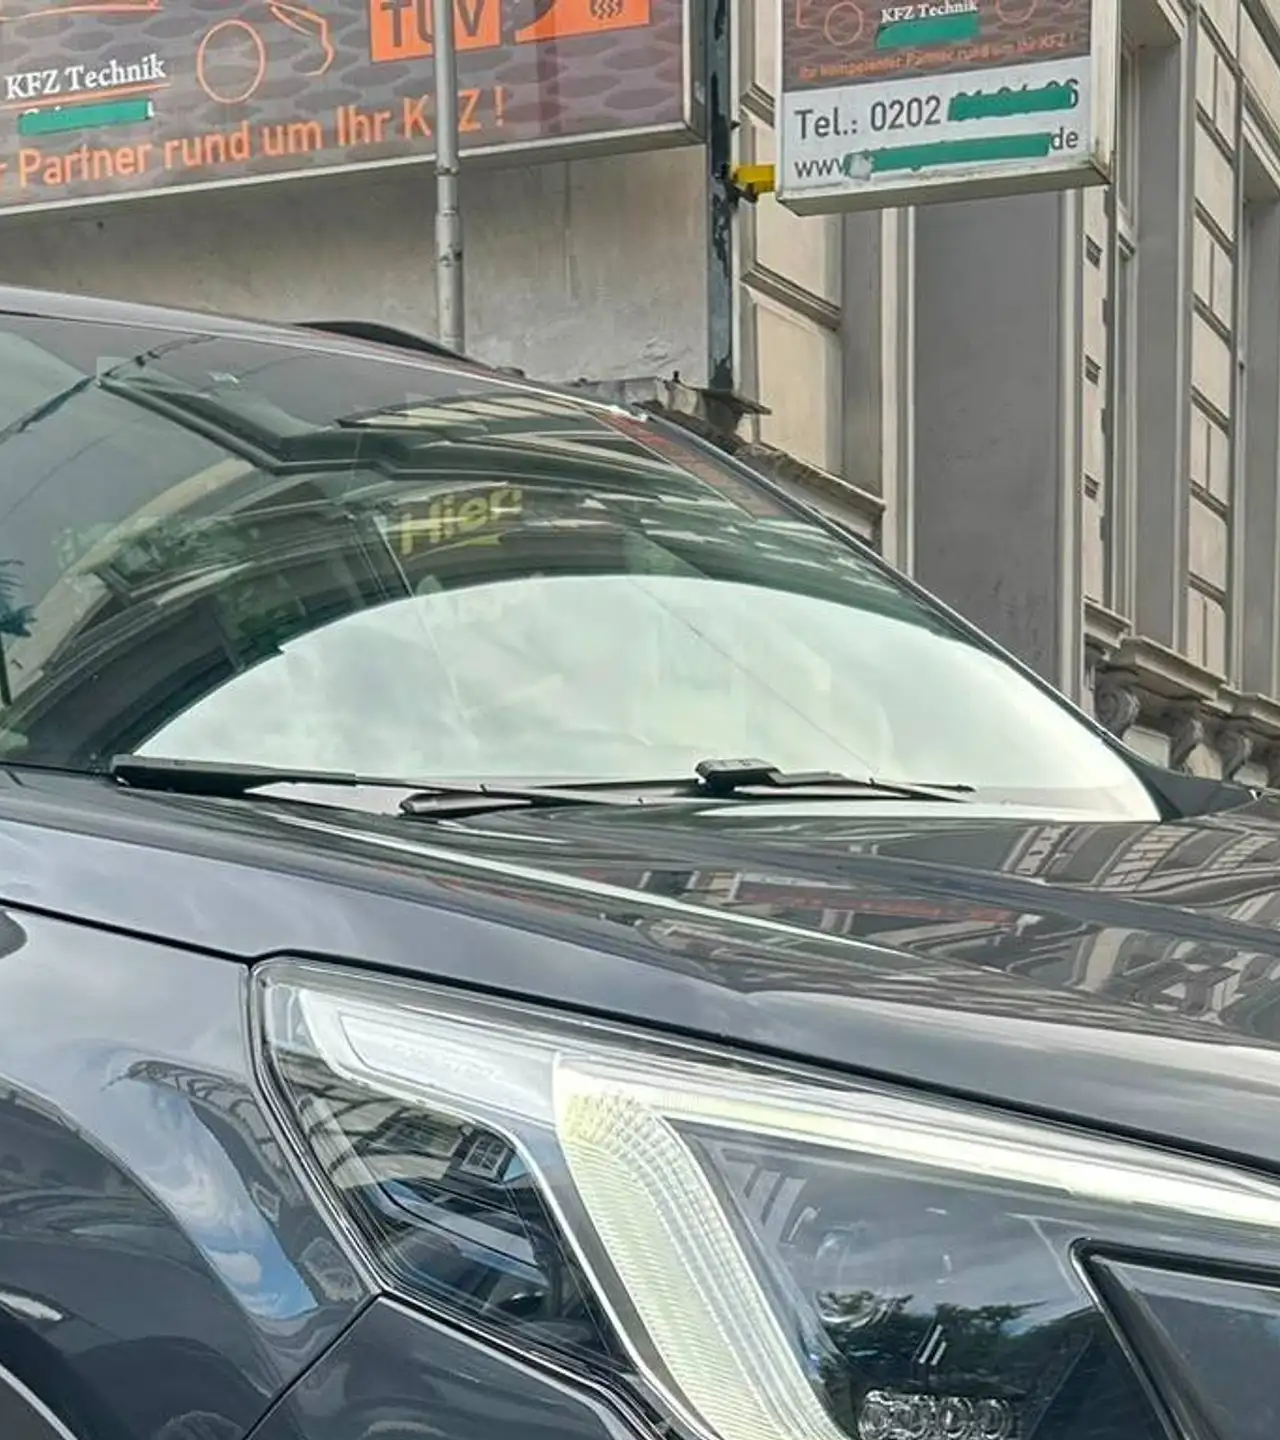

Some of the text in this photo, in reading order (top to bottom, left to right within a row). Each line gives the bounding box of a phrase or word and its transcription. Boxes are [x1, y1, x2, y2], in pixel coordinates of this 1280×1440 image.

[880, 0, 979, 23] KFZ Technik
[4, 52, 167, 100] KFZ Technik
[19, 143, 152, 188] Partner
[164, 120, 250, 171] rund
[262, 119, 324, 157] um
[337, 104, 392, 147] Ihr
[403, 88, 482, 140] KZ
[794, 107, 858, 140] Tel.:
[870, 95, 941, 132] 0202
